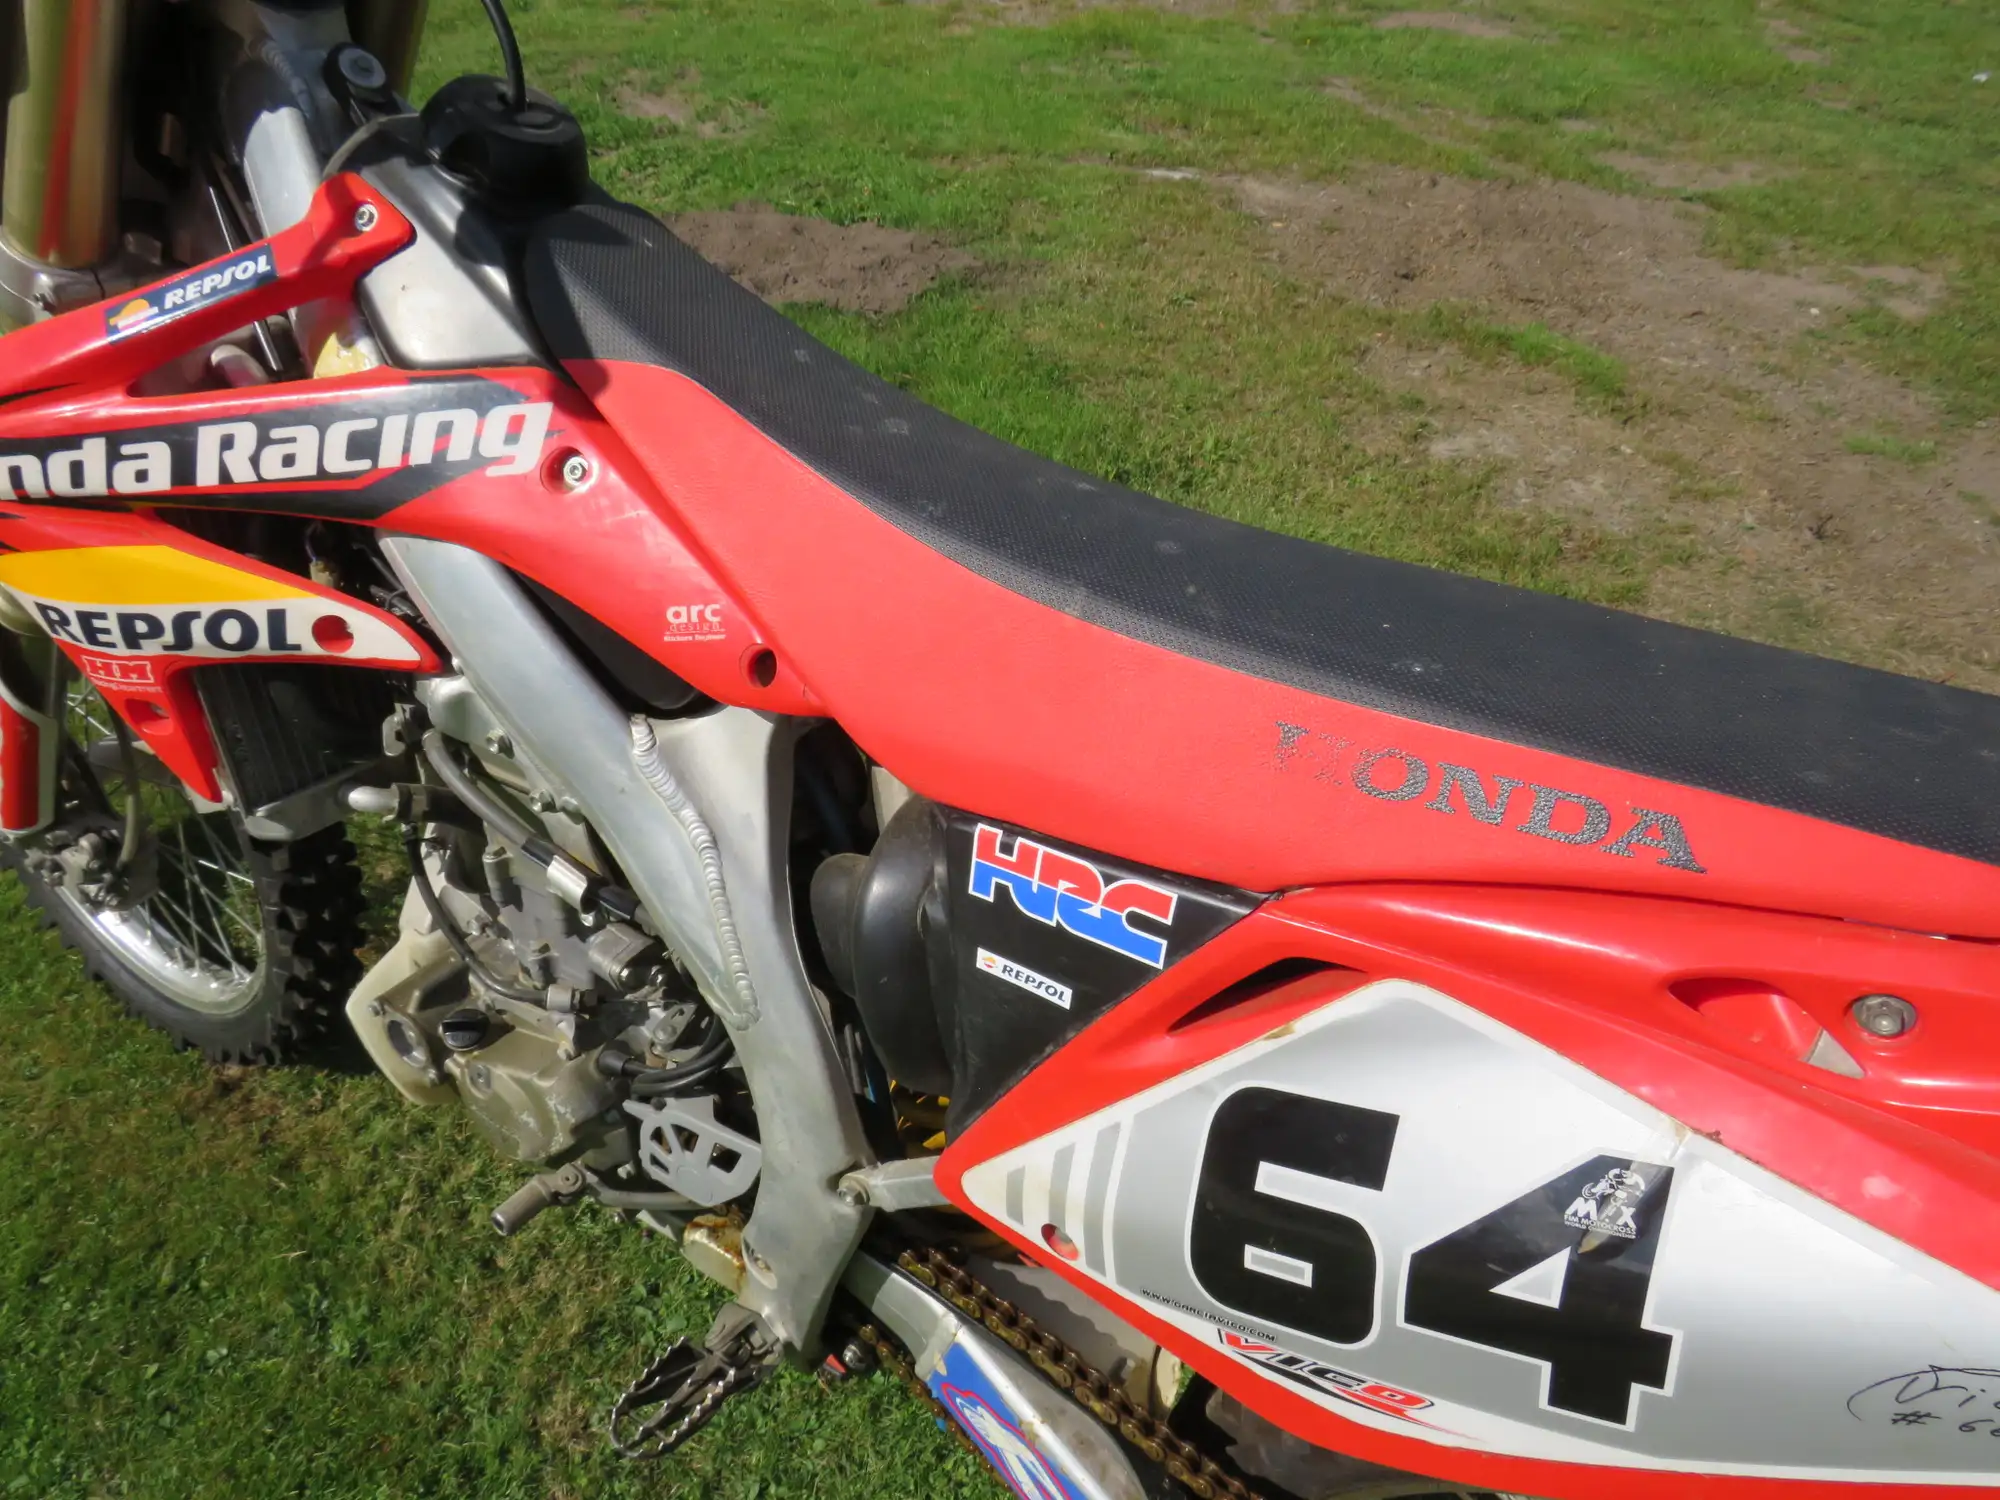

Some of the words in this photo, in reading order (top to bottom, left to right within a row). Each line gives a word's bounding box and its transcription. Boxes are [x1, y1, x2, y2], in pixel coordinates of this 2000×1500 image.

[164, 255, 271, 309] REPSOL
[196, 402, 553, 487] Racing
[34, 601, 301, 652] REPSOL
[666, 604, 721, 624] arc
[669, 622, 720, 633] design
[968, 823, 1178, 969] HRC
[1001, 964, 1066, 1003] REPSOL
[1564, 1214, 1579, 1224] FIM
[1581, 1217, 1636, 1235] MOTOCROSS
[1190, 1086, 1675, 1426] 64
